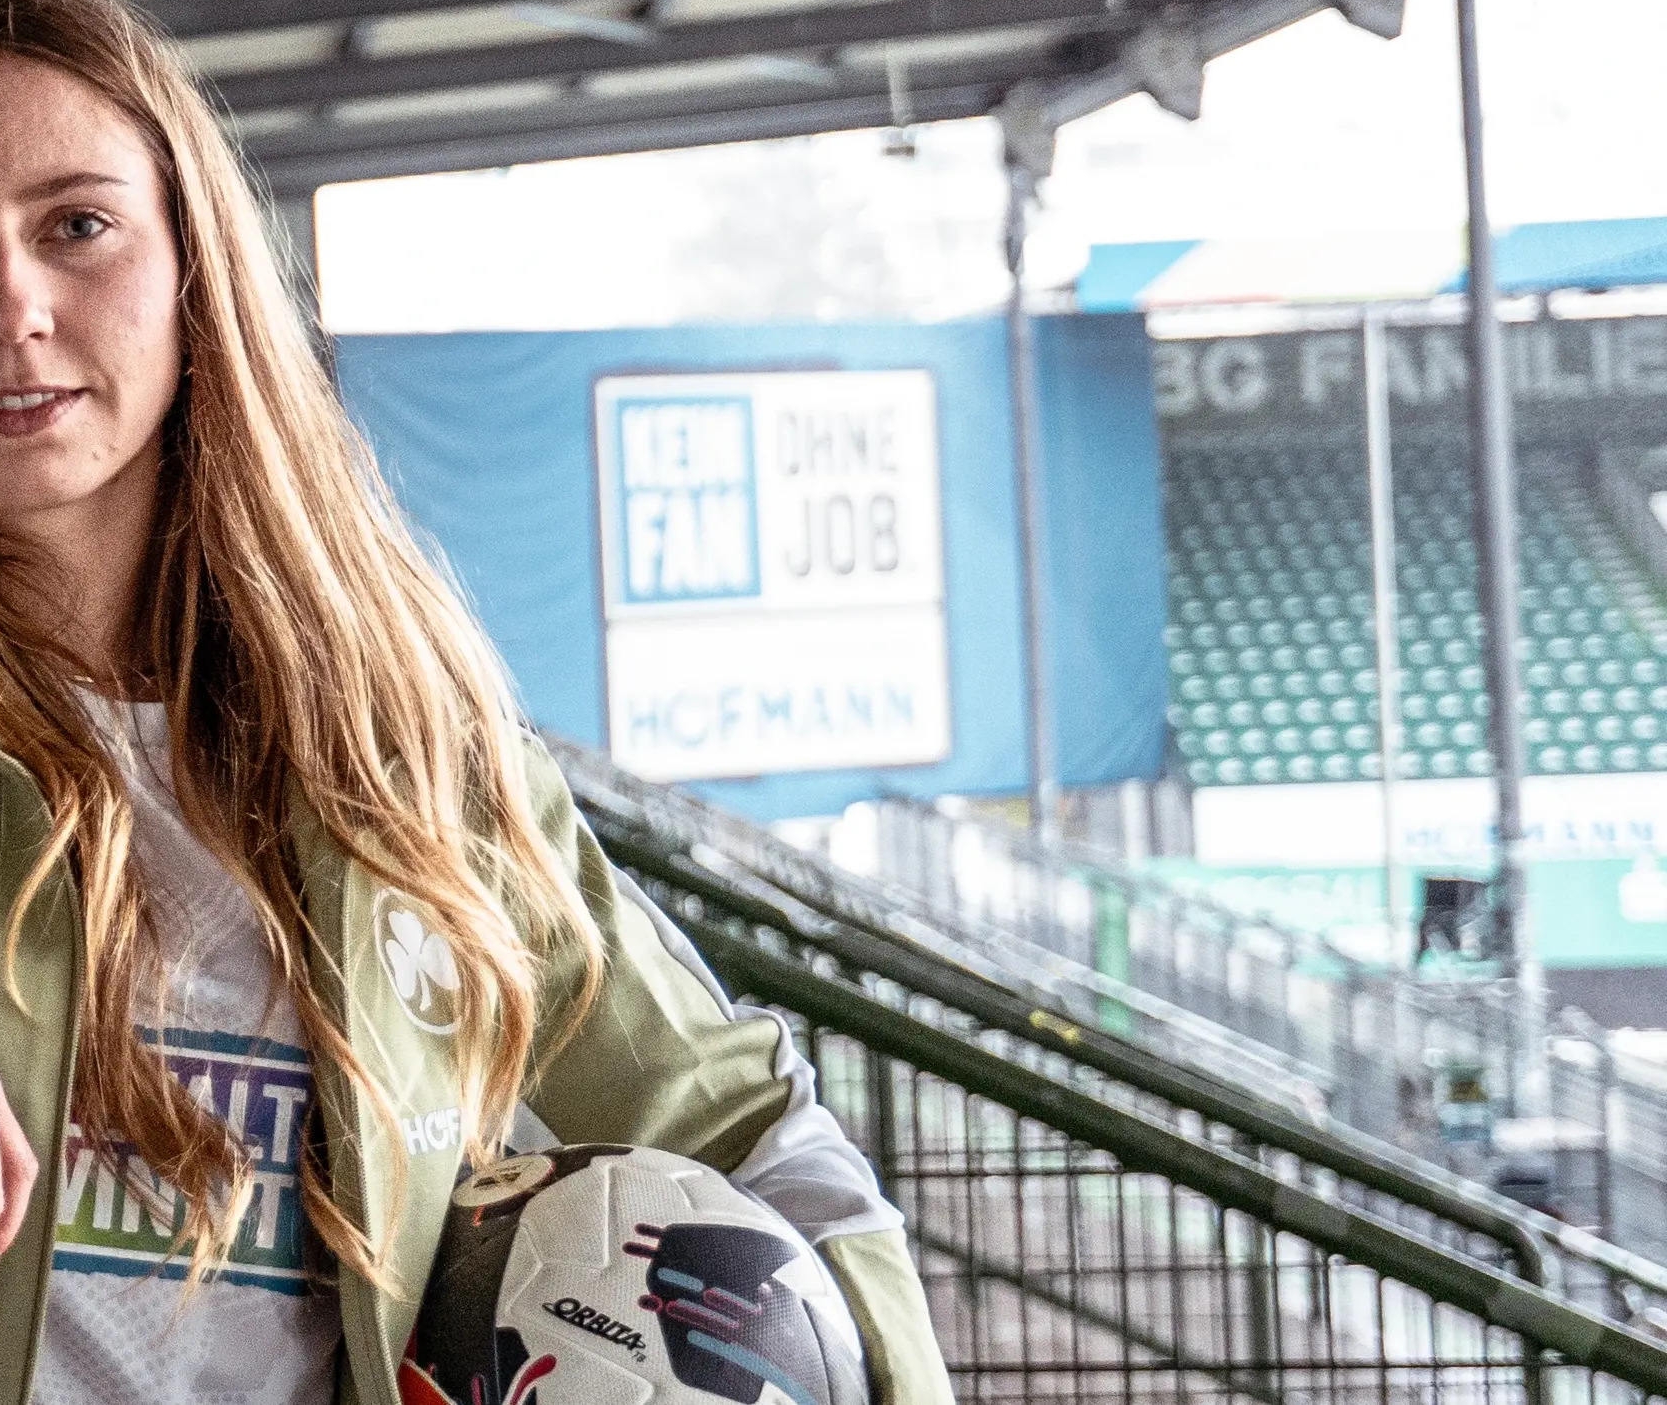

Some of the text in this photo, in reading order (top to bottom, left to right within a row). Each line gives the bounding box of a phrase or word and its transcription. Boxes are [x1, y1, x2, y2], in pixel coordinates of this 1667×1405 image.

[776, 405, 899, 475] OHNE
[785, 493, 900, 577] JOB
[627, 682, 916, 748] HOFMANN
[549, 1297, 646, 1352] ORBITA
